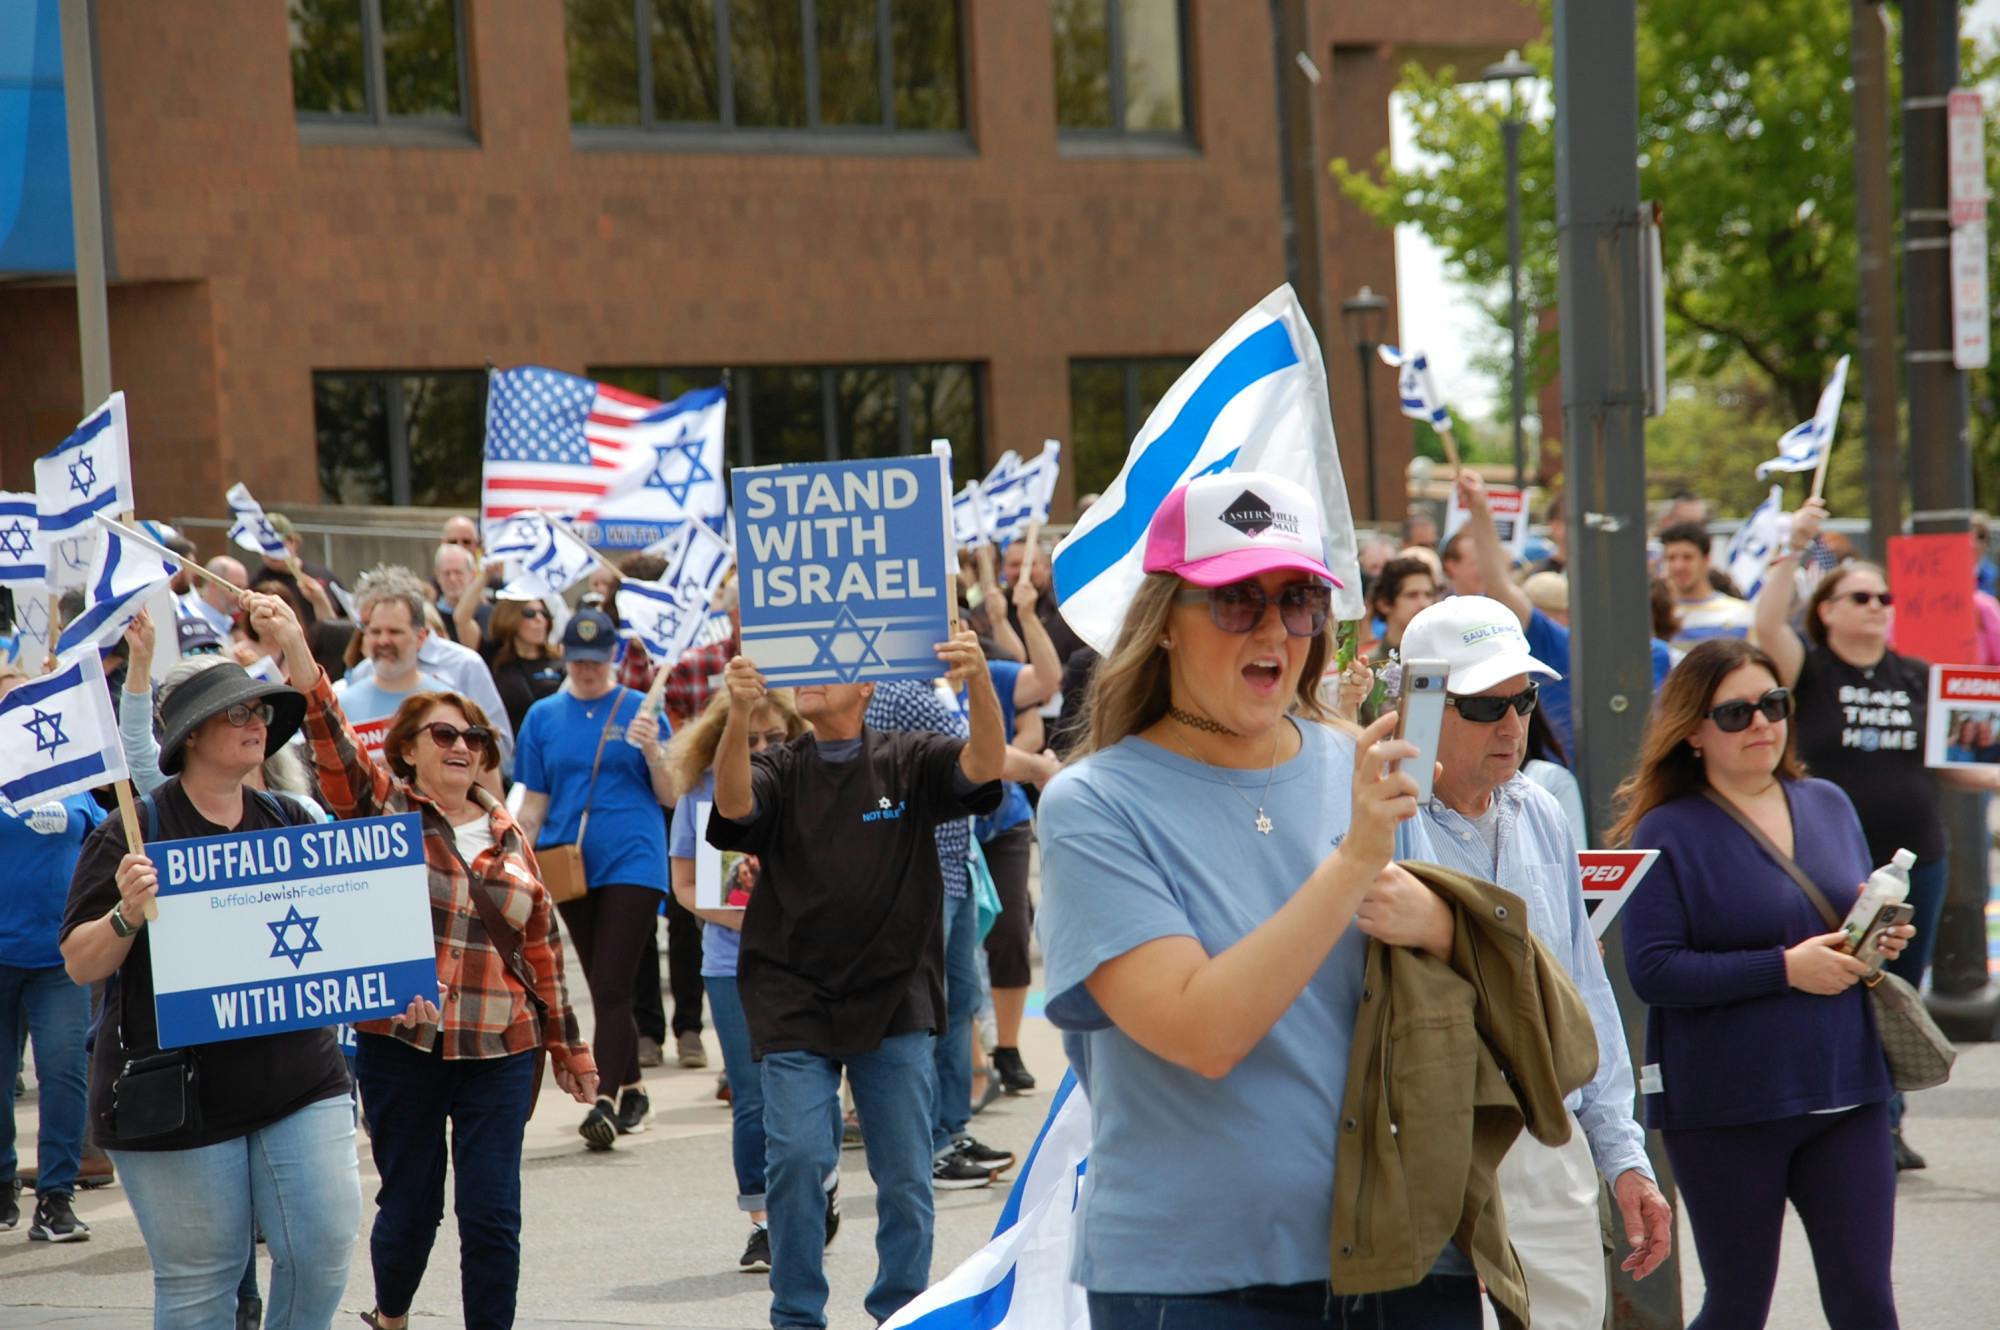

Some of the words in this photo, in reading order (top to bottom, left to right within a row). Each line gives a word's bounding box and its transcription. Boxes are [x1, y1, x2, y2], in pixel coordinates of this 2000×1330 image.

[746, 468, 919, 519] STAND
[1221, 510, 1272, 521] EASTERN
[1272, 511, 1298, 523] HILLS
[747, 515, 887, 563] WITH
[1273, 522, 1300, 534] MALL
[752, 559, 937, 608] ISRAEL
[1462, 628, 1491, 644] SAUL
[1842, 705, 1912, 727] THEM
[862, 810, 881, 822] NOT
[167, 835, 292, 886] BUFFALO
[301, 822, 410, 869] STANDS
[1580, 865, 1625, 882] PED
[211, 985, 287, 1030] WITH
[294, 971, 396, 1019] ISRAEL
